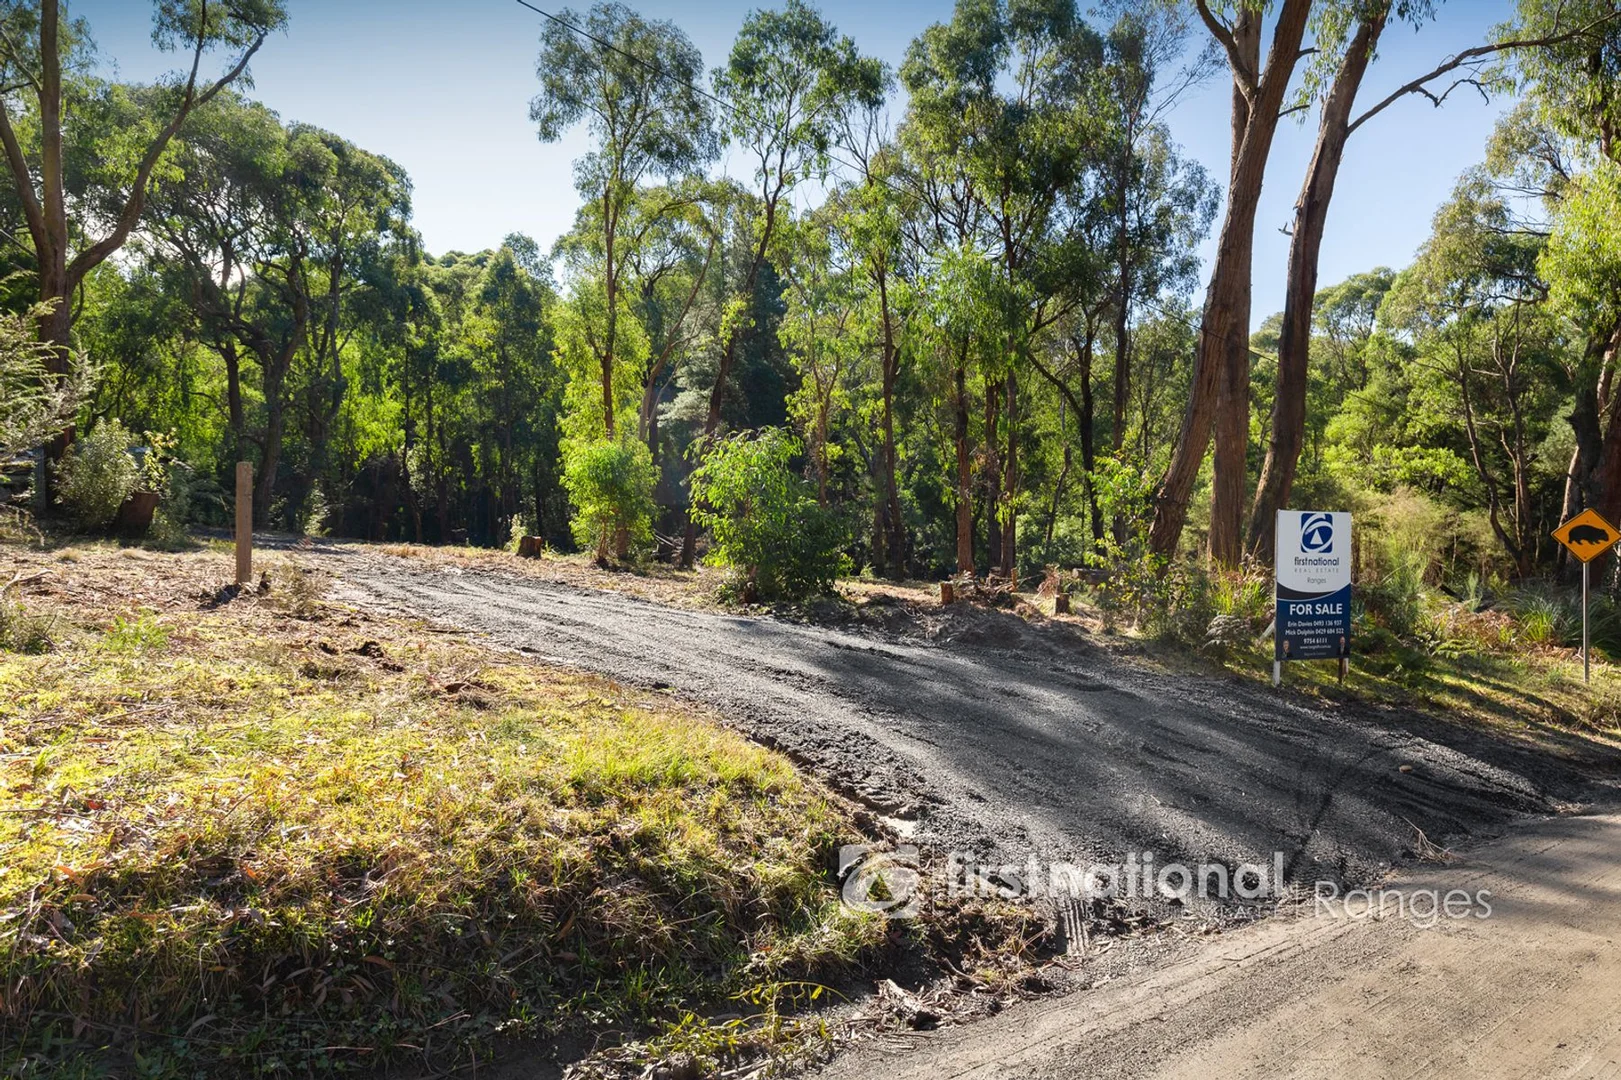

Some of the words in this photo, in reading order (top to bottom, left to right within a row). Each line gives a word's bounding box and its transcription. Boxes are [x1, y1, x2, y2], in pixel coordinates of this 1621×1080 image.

[1294, 557, 1340, 566] firstnational
[1307, 577, 1327, 585] Ranges
[1289, 604, 1313, 615] FOR
[1315, 603, 1343, 615] SALE
